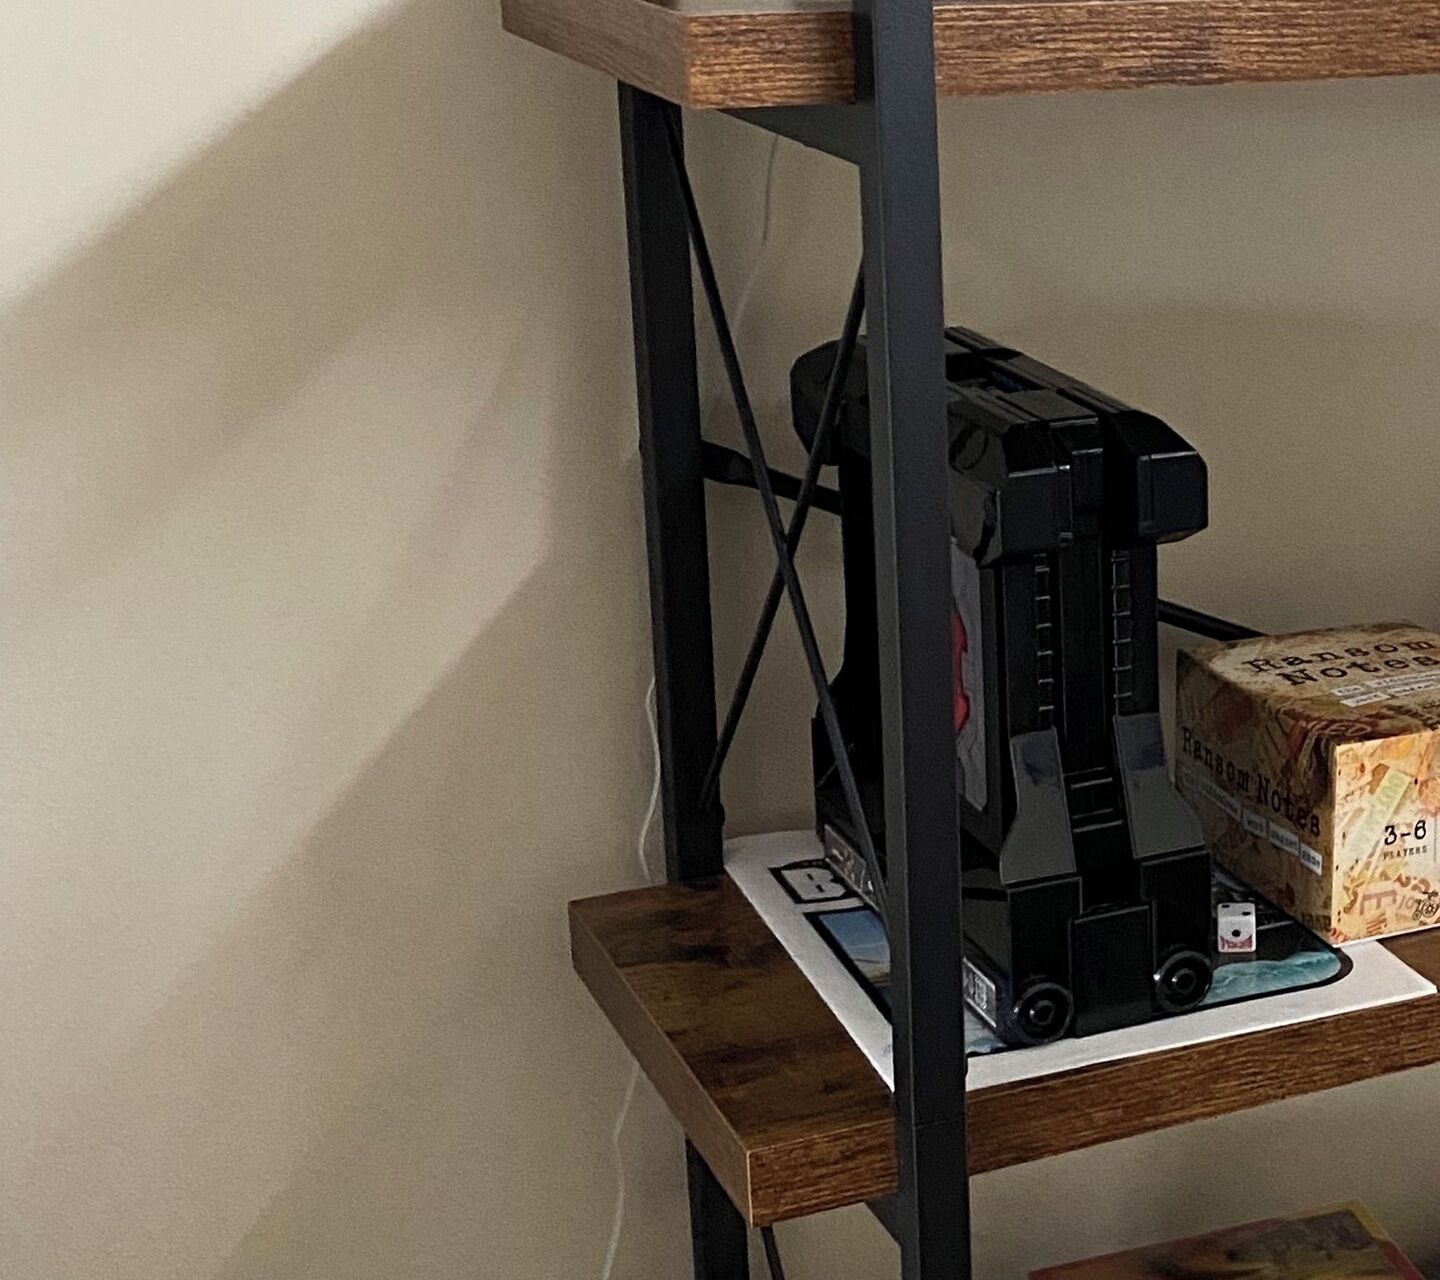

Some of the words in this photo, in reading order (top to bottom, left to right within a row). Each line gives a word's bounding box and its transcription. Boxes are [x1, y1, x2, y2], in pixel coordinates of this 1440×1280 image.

[1242, 639, 1437, 674] Ransom
[1181, 724, 1250, 793] Ransom
[1256, 772, 1321, 838] Notes
